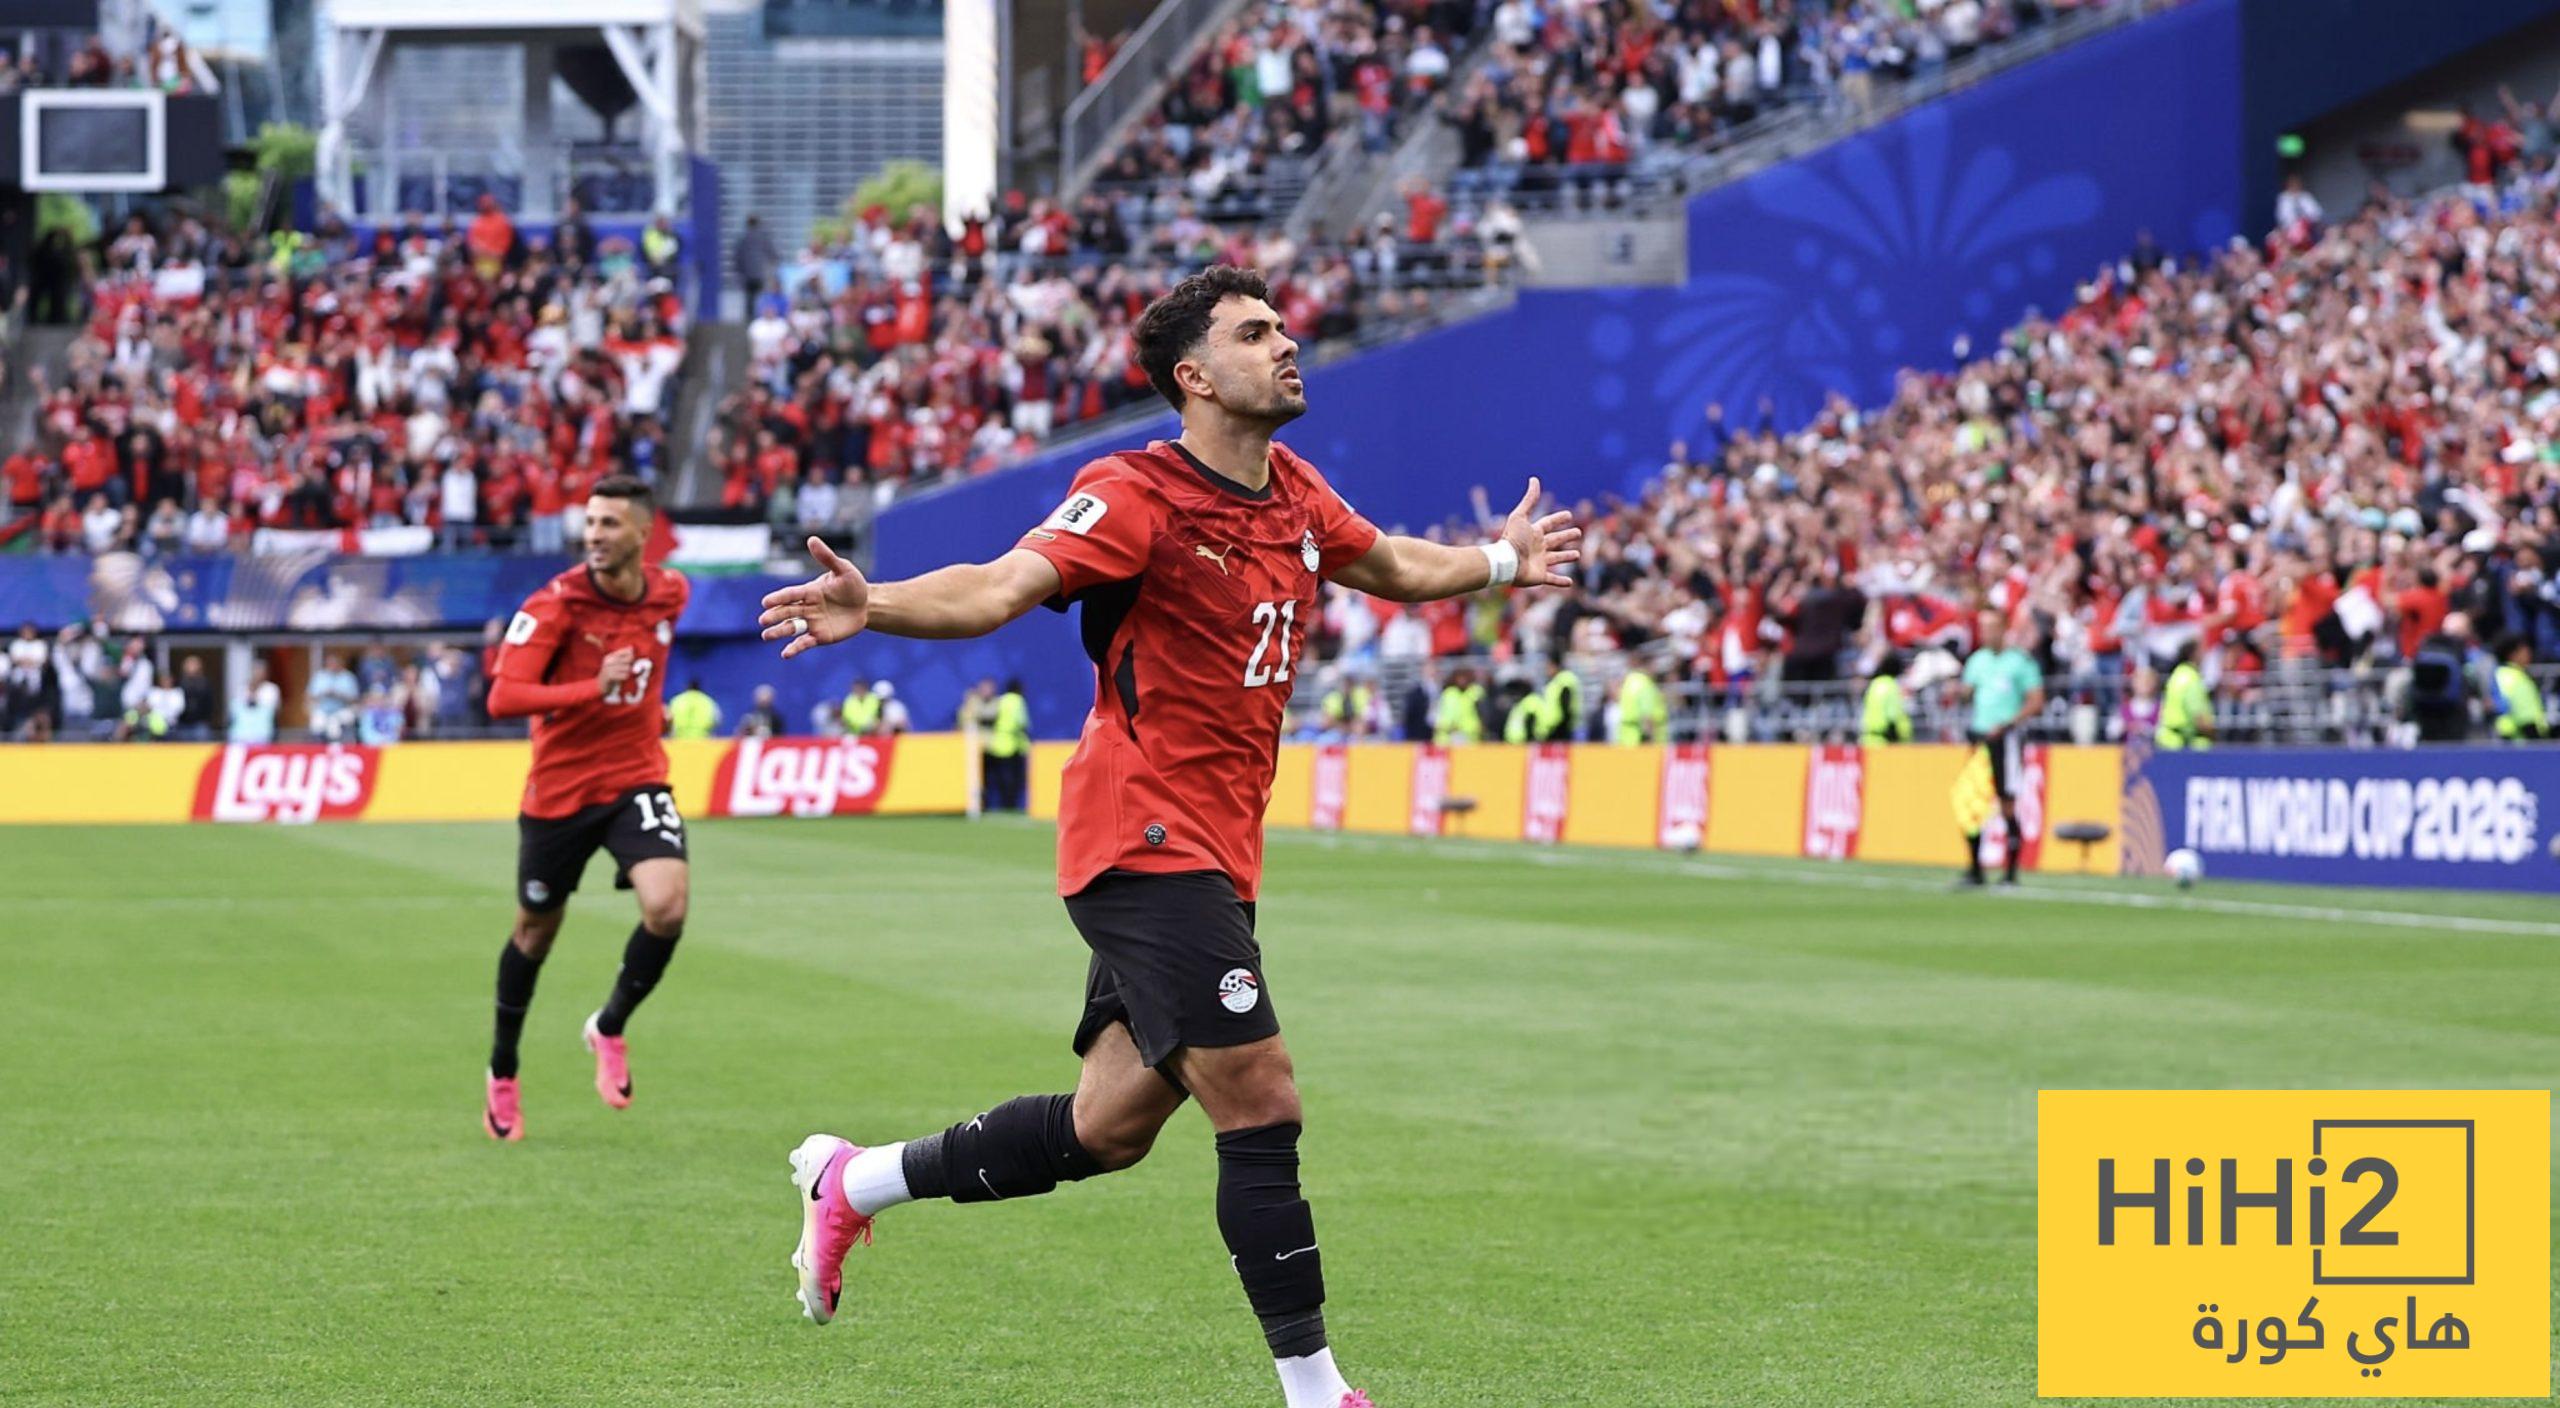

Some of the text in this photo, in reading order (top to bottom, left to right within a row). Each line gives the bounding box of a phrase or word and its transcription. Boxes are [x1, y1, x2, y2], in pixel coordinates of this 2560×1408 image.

[1244, 600, 1297, 687] 21
[212, 743, 364, 824] Lay's
[634, 792, 681, 830] 13
[729, 736, 879, 818] Lay's
[2185, 777, 2246, 852] FIFA
[2246, 777, 2350, 857] WORLD
[2352, 777, 2413, 859] CUP
[2412, 777, 2527, 863] 2026
